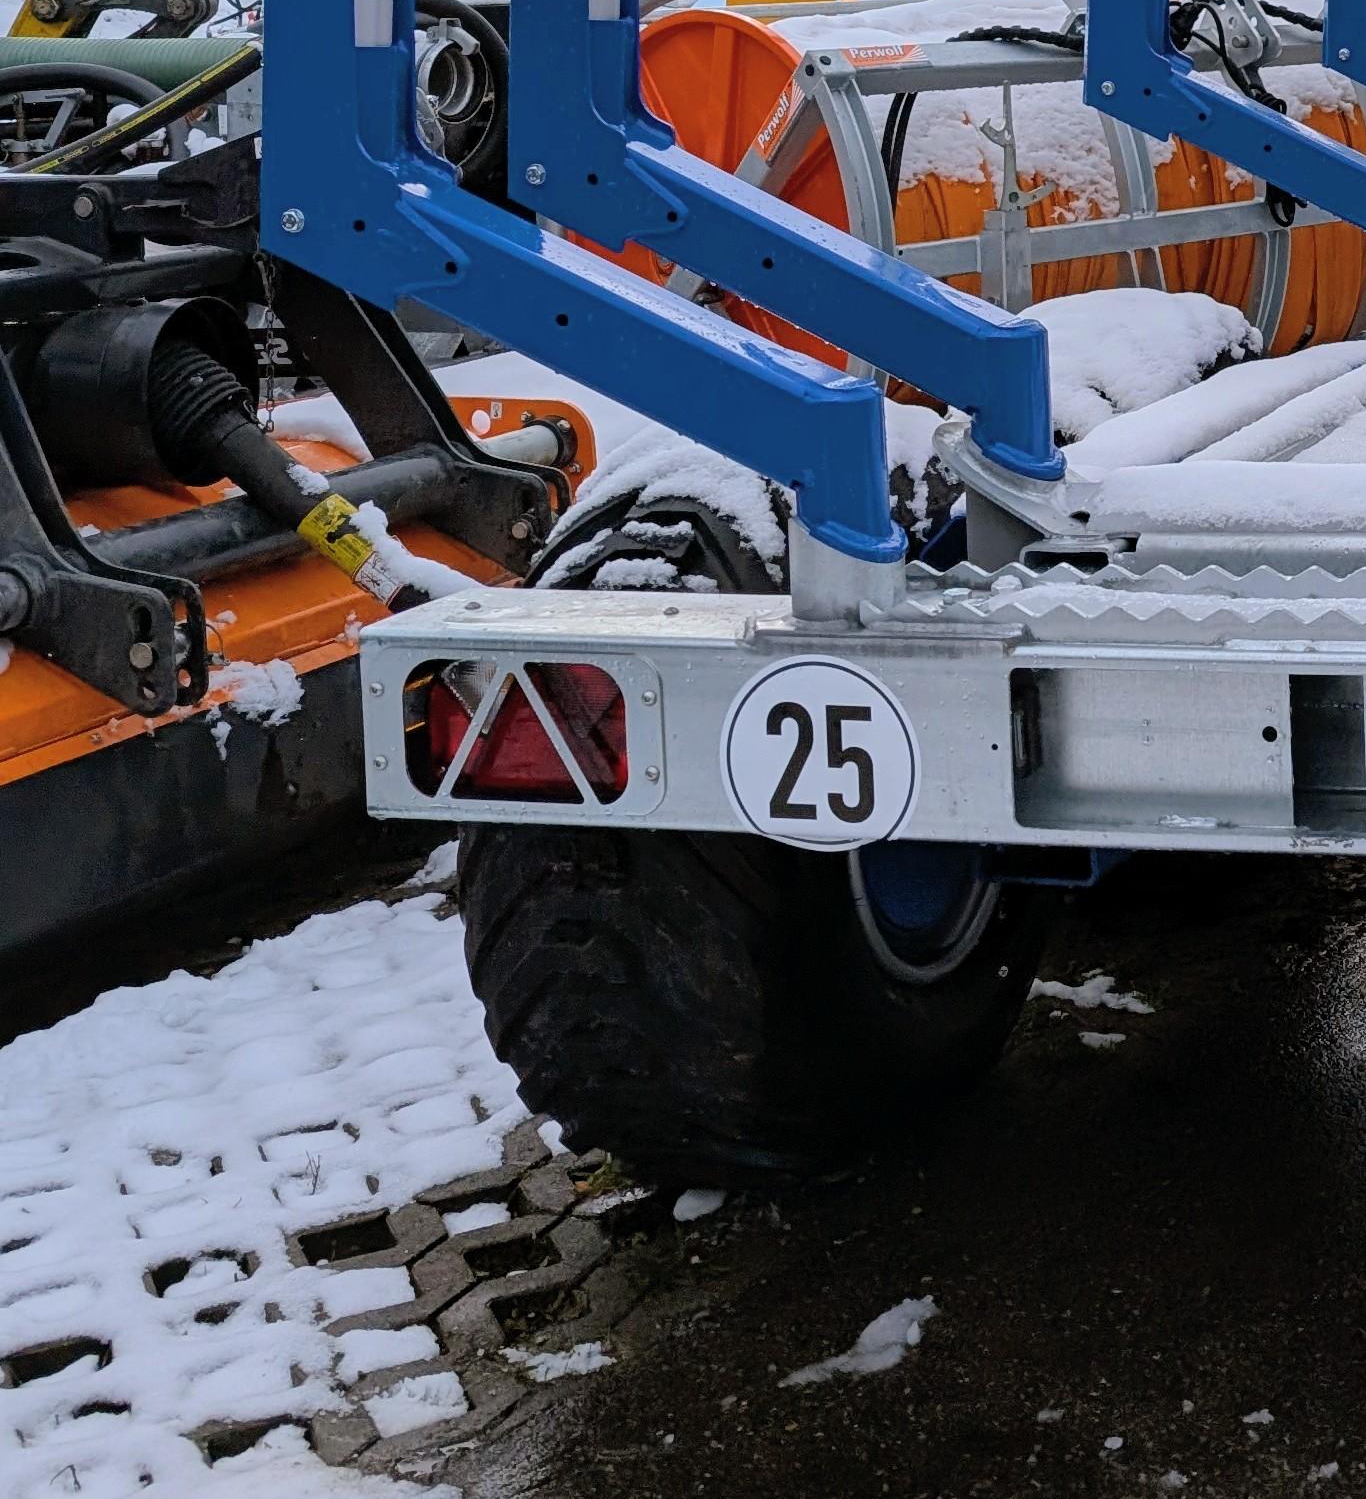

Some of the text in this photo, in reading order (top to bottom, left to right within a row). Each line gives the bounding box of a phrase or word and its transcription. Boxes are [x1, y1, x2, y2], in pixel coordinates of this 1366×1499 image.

[849, 45, 905, 59] Perwolf
[756, 91, 791, 149] Perwolf
[766, 701, 875, 824] 25
